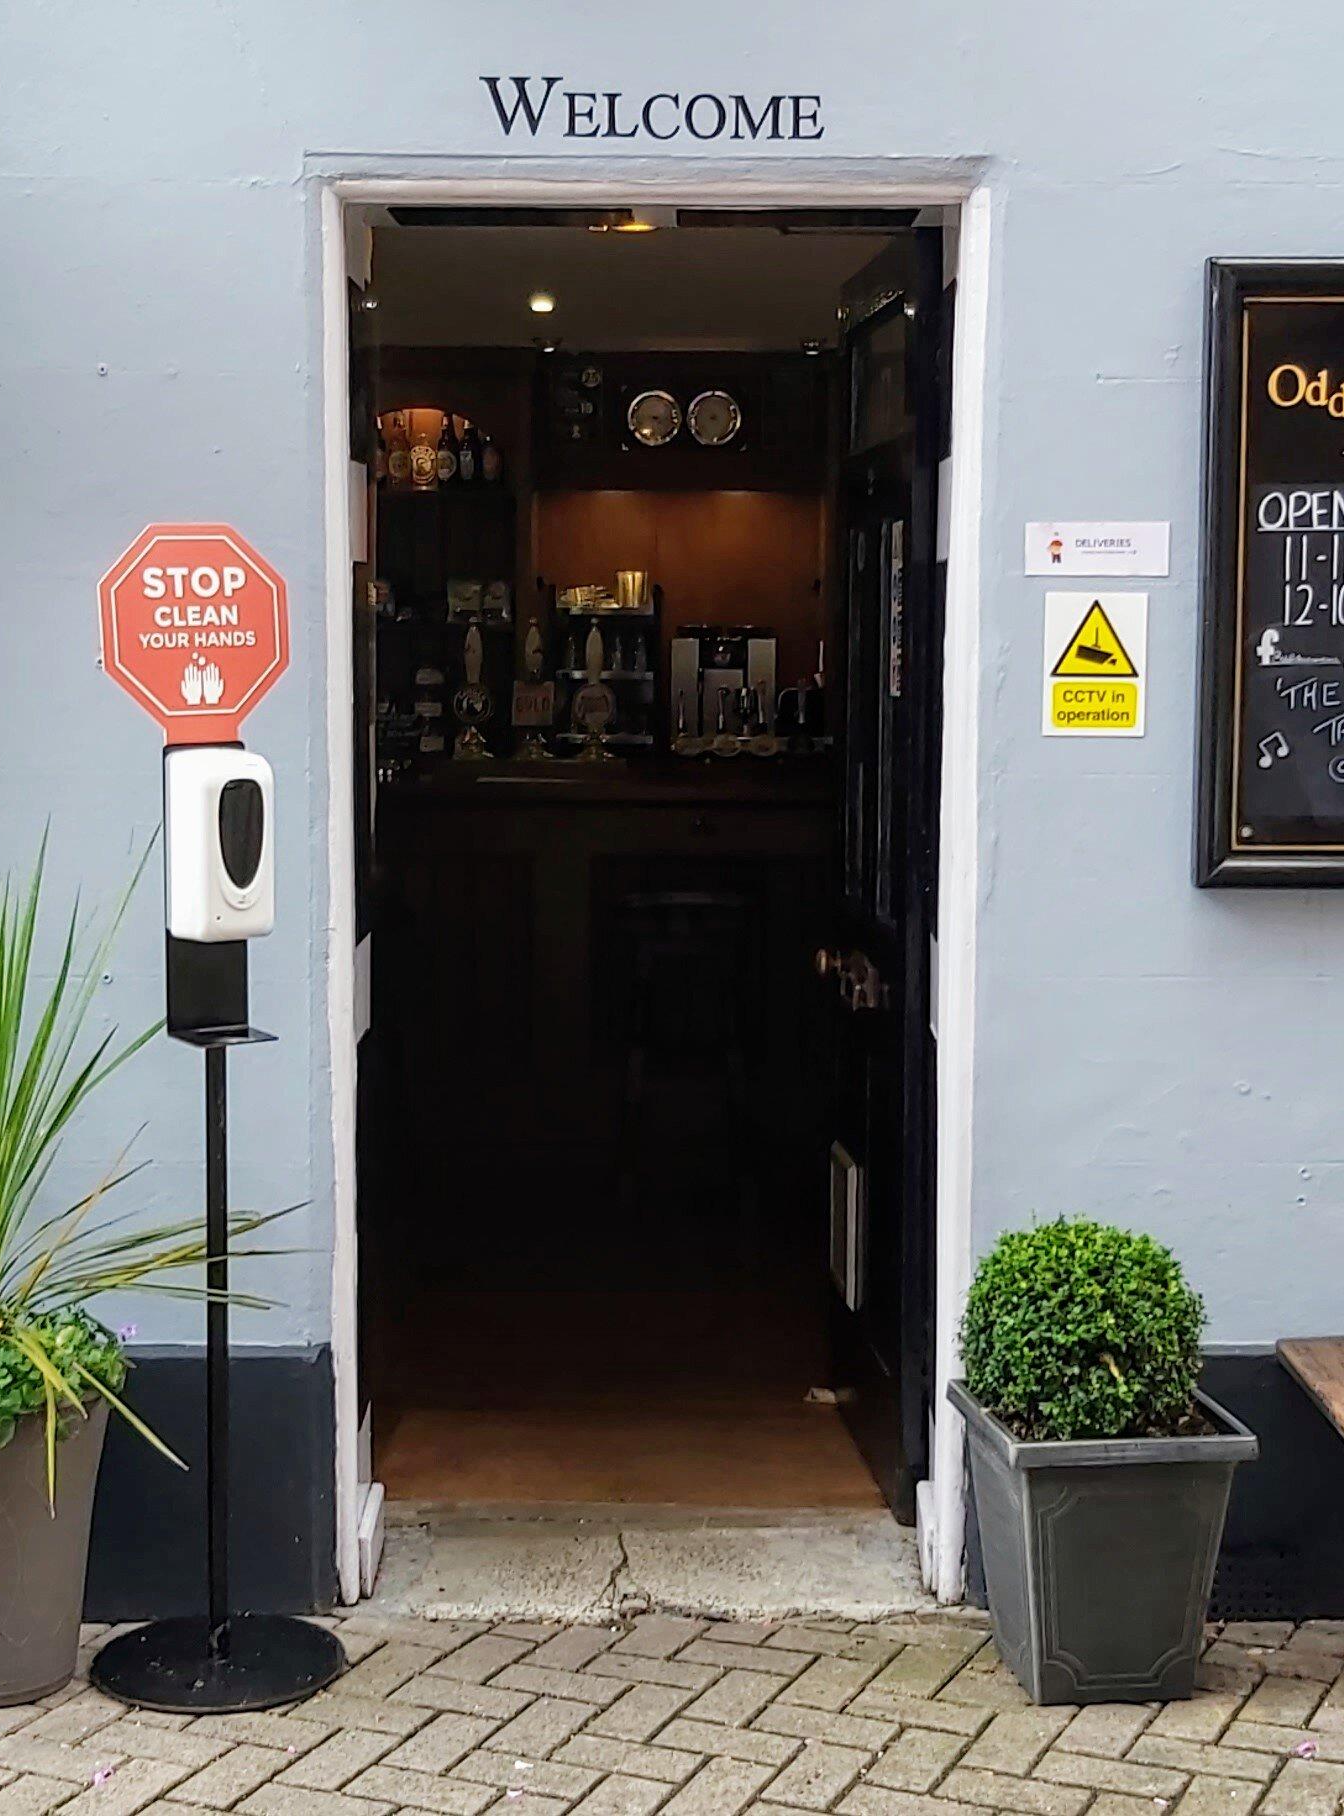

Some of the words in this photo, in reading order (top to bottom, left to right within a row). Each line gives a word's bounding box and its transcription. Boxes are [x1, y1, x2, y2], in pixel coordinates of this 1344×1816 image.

[478, 76, 825, 140] WELCOME
[1075, 538, 1131, 548] DELIVERIES
[142, 566, 247, 599] STOP
[154, 605, 239, 627] CLEAN
[138, 632, 190, 649] YOUR
[195, 631, 257, 649] HANDS
[1062, 690, 1107, 702] CCTV
[1111, 690, 1125, 703] in
[1056, 708, 1130, 724] operation
